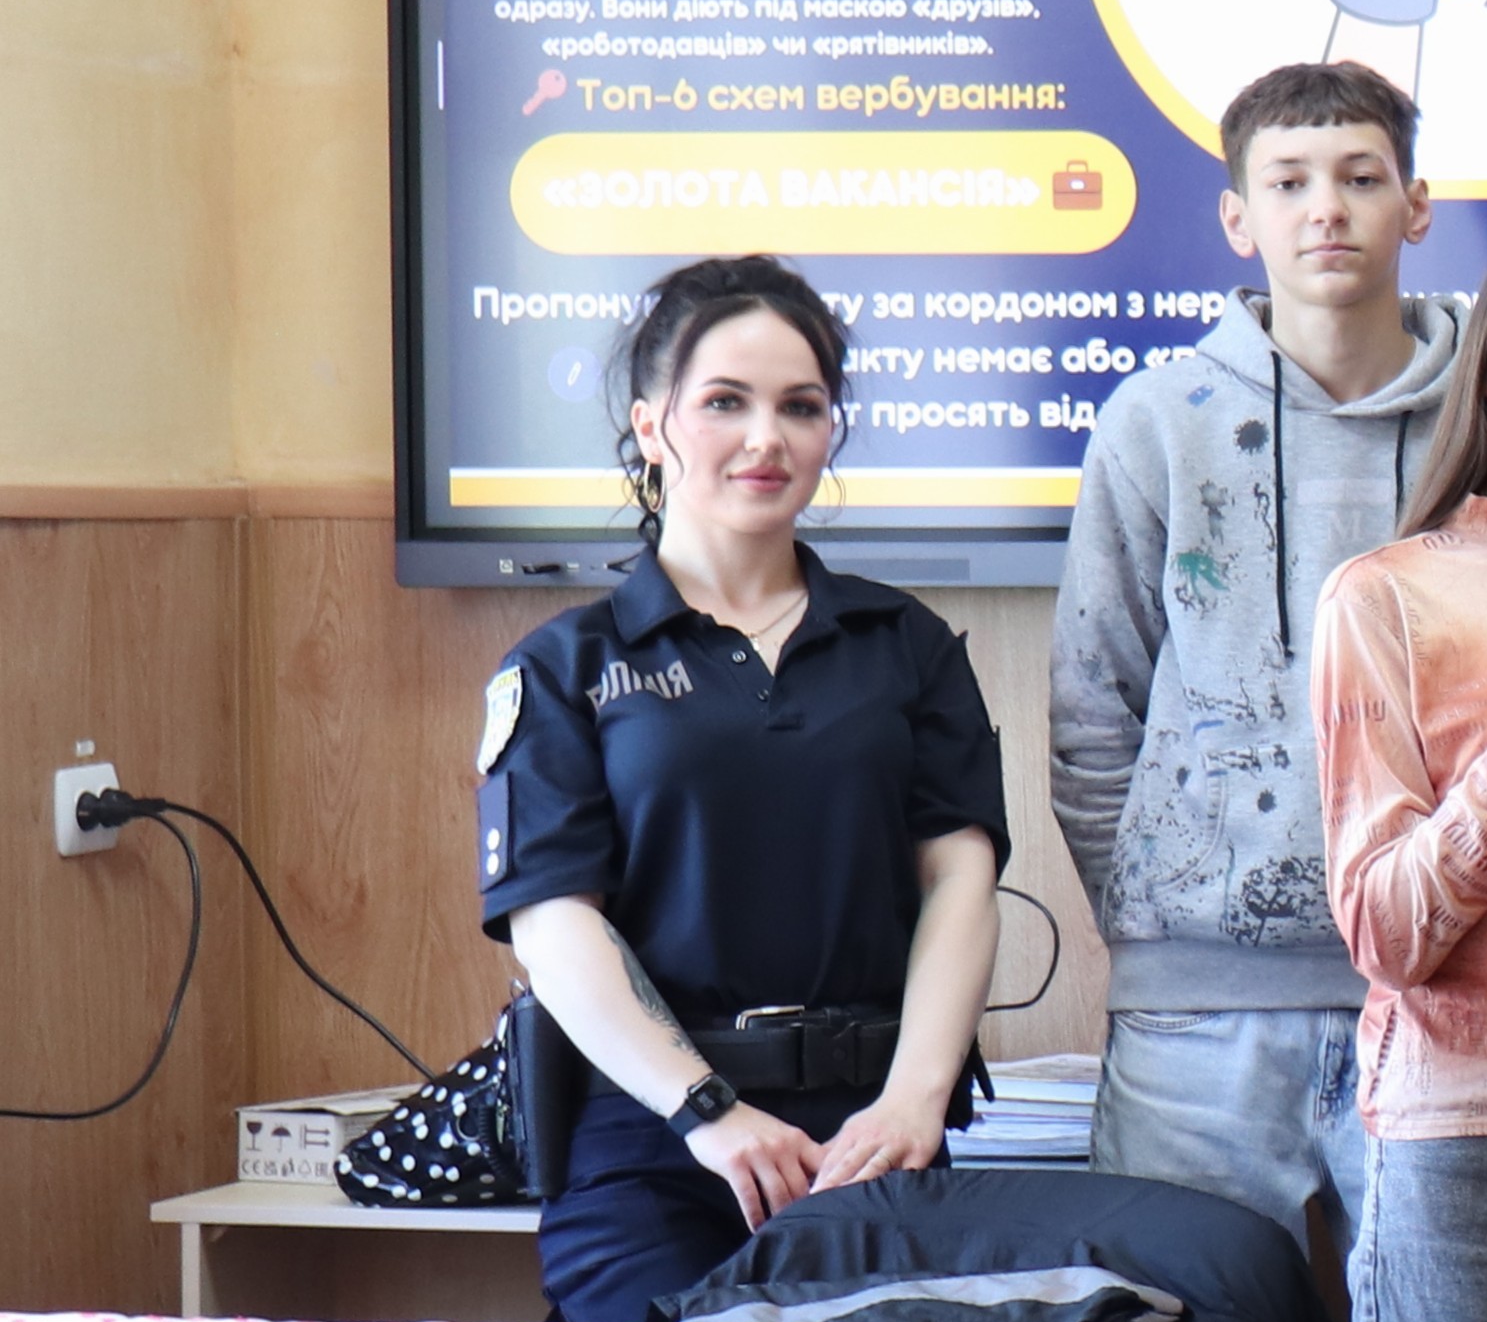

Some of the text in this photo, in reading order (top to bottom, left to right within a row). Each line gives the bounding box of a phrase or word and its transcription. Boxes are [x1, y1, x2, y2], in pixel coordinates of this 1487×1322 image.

[541, 31, 767, 59] «роботодавців»
[772, 35, 808, 57] чи
[706, 82, 805, 112] схем
[815, 75, 1067, 117] вербування:
[541, 167, 1041, 209] «ЗОЛОТА ВАКАНСІЯ»
[472, 285, 662, 325] Пропону
[872, 291, 915, 320] за
[924, 290, 1119, 325] кордоном
[1153, 291, 1228, 325] нер
[932, 345, 1054, 375] немає
[1060, 337, 1137, 375] або
[870, 400, 1032, 434] просять
[1038, 393, 1102, 434] від
